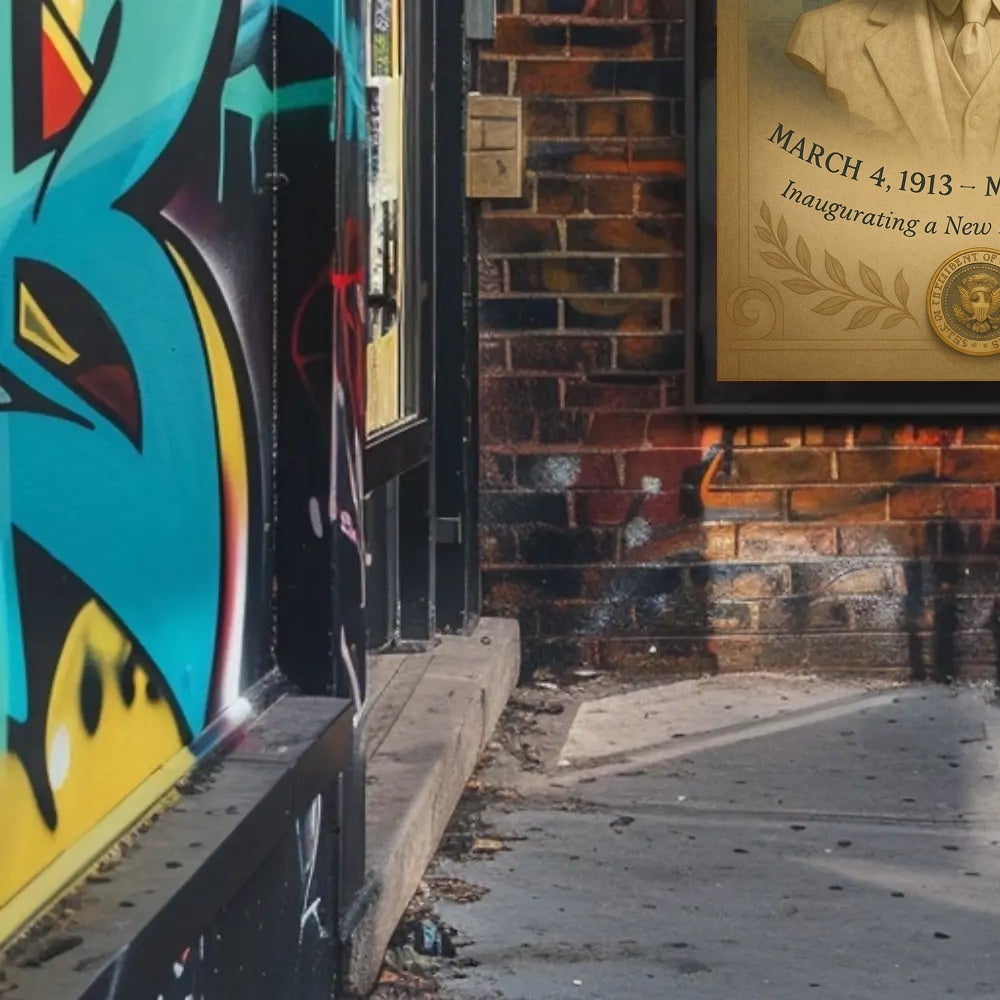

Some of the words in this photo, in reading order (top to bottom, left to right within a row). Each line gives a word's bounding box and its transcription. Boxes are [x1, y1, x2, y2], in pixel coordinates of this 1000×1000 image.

[767, 122, 864, 182] MARCH
[898, 170, 954, 197] 1913
[780, 179, 920, 238] Inaugurating
[924, 221, 938, 235] a
[944, 215, 993, 236] New
